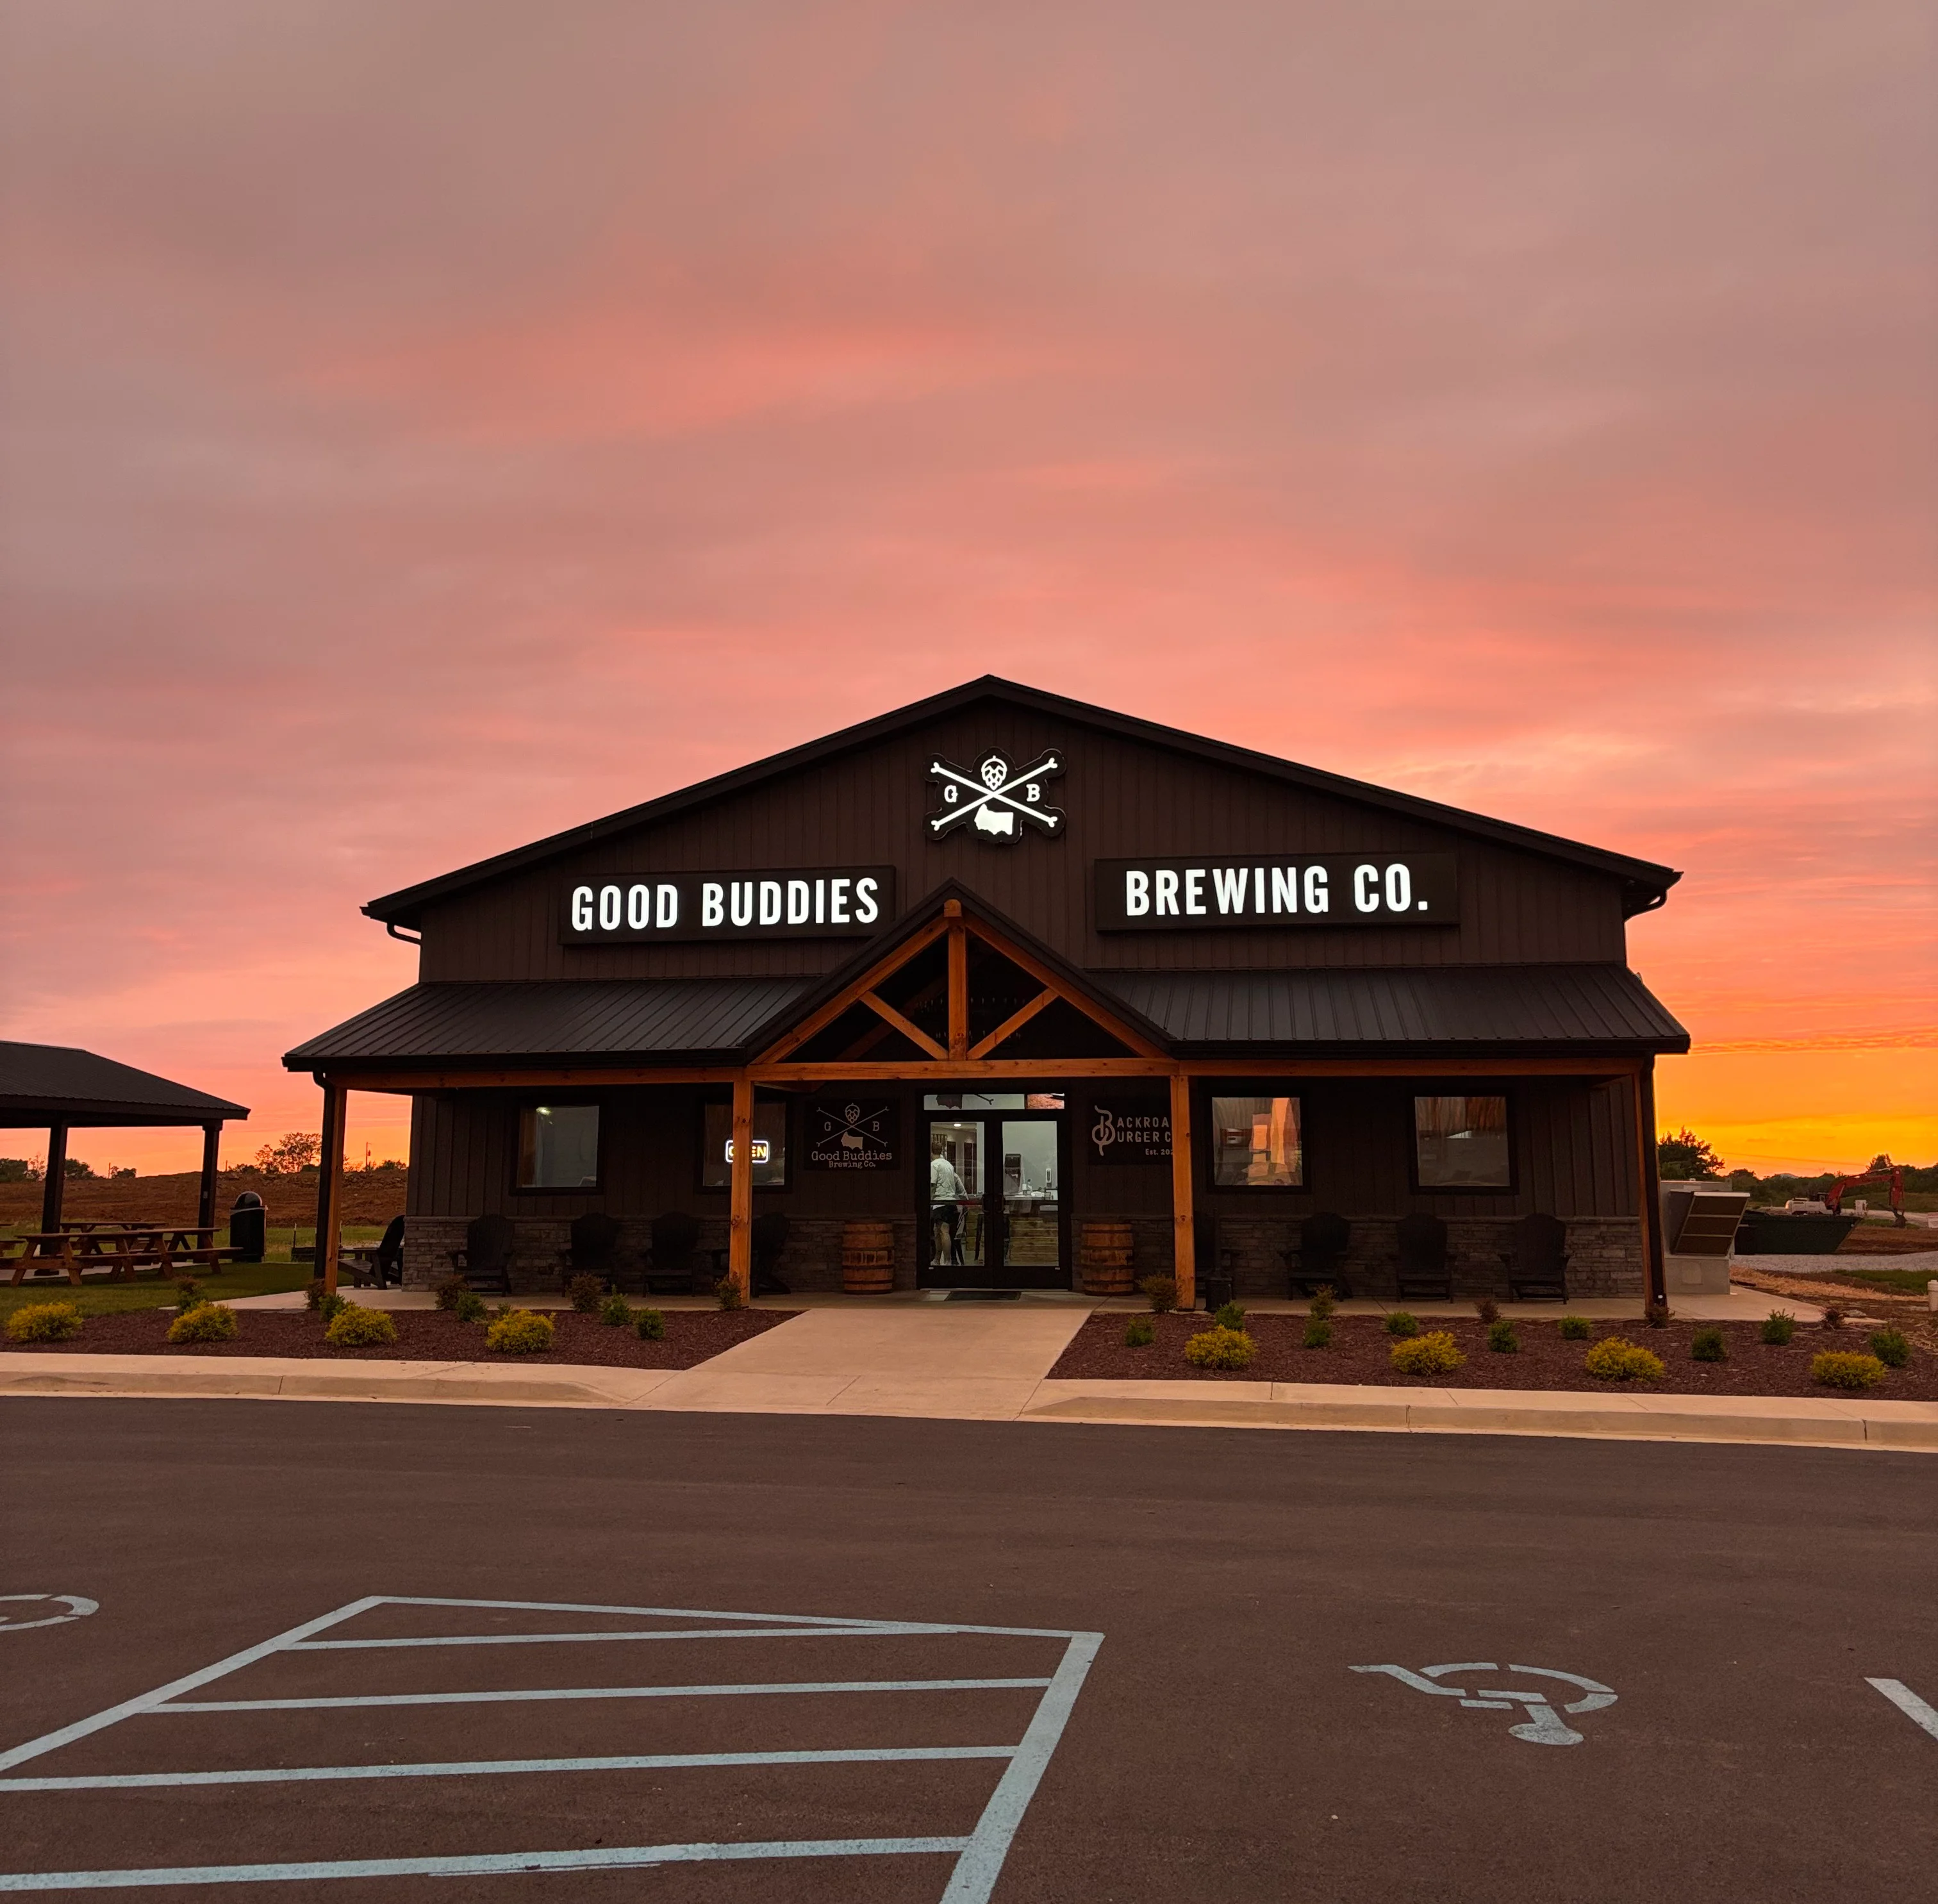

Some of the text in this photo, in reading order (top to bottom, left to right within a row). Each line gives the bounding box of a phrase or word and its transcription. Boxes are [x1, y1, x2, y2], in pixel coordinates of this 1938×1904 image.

[944, 783, 1041, 803] G B
[1126, 863, 1428, 916] BREWING CO.
[572, 877, 878, 931] GOOD BUDDIES
[824, 1121, 880, 1132] G B
[728, 1145, 766, 1158] OEN
[811, 1150, 893, 1161] Good Buddies
[1145, 1148, 1159, 1156] Est.
[828, 1161, 863, 1170] Brewing
